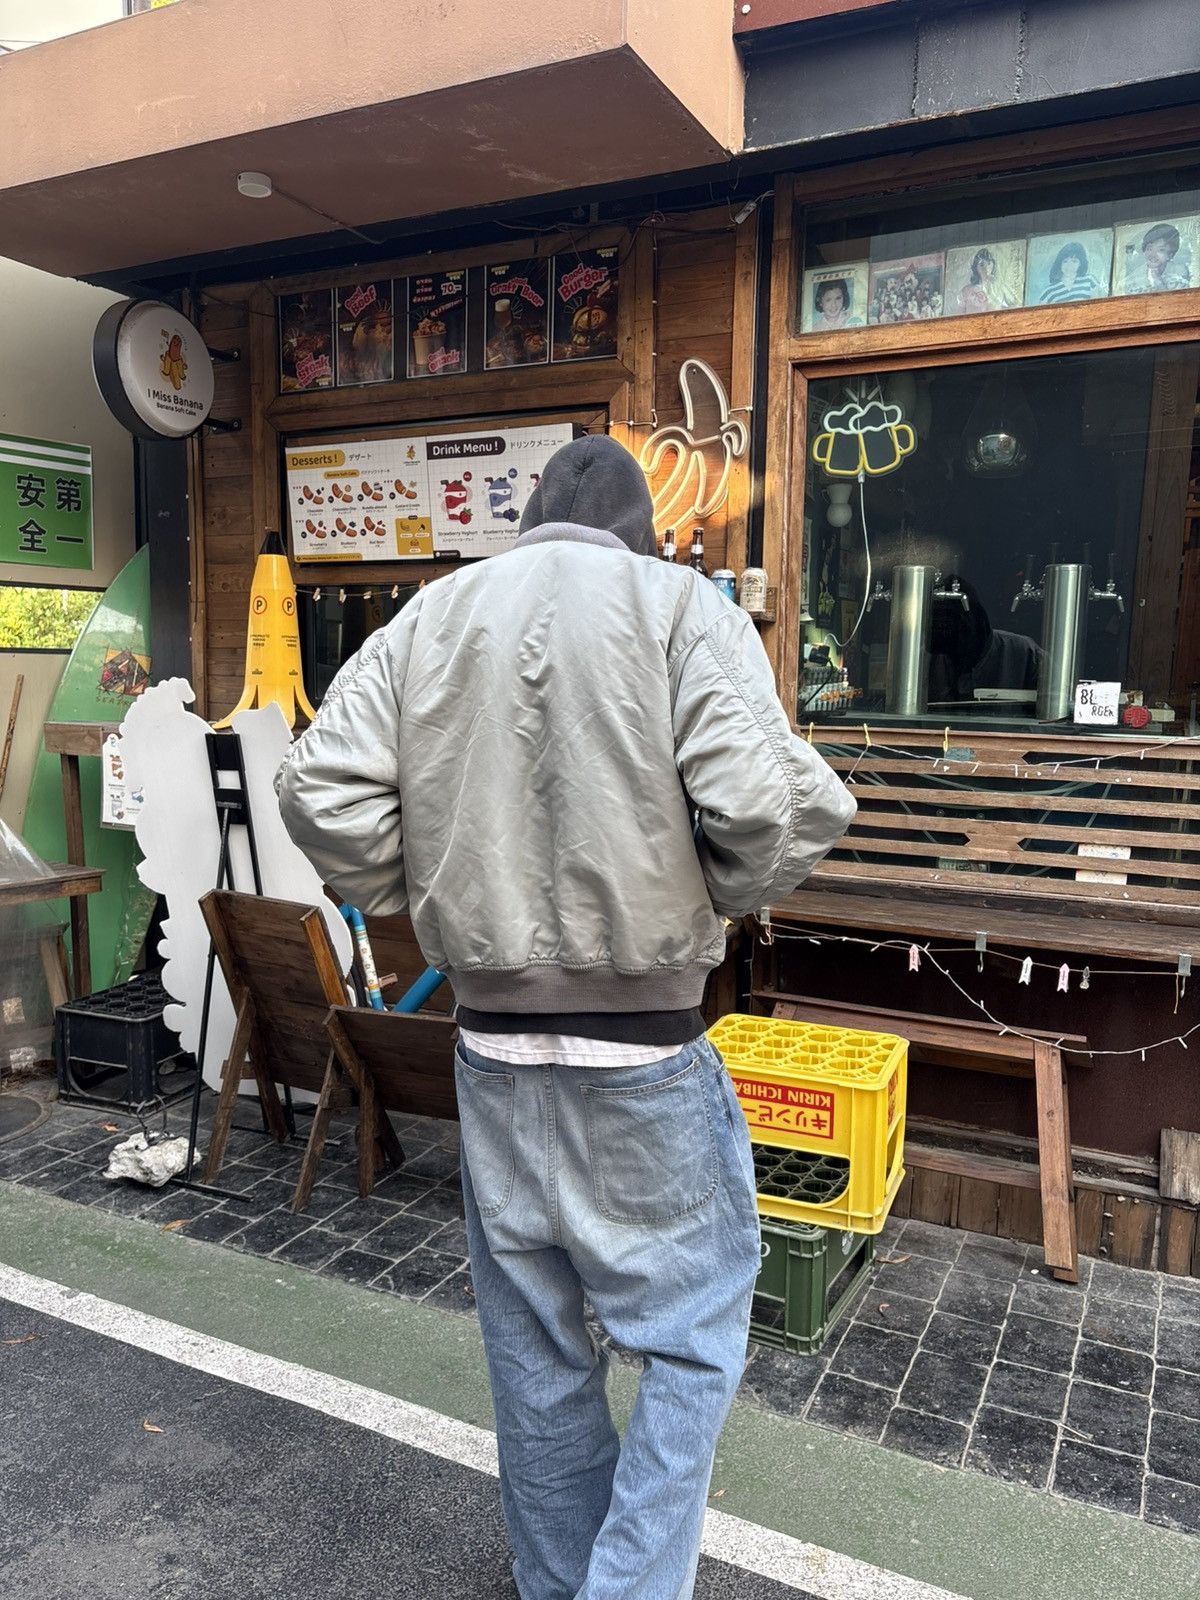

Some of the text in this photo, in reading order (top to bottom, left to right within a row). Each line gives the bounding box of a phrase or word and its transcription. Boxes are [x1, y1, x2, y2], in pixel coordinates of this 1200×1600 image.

[561, 271, 607, 298] Burger
[152, 390, 172, 403] Miss
[174, 395, 204, 410] Banana
[510, 440, 564, 449] ドリンクメニュー
[432, 445, 460, 456] Drink
[349, 453, 372, 462] デザート
[256, 600, 262, 610] P
[287, 601, 292, 612] P
[734, 1082, 831, 1108] KIRIN ICHIBA
[742, 1105, 828, 1130] キリンビー
